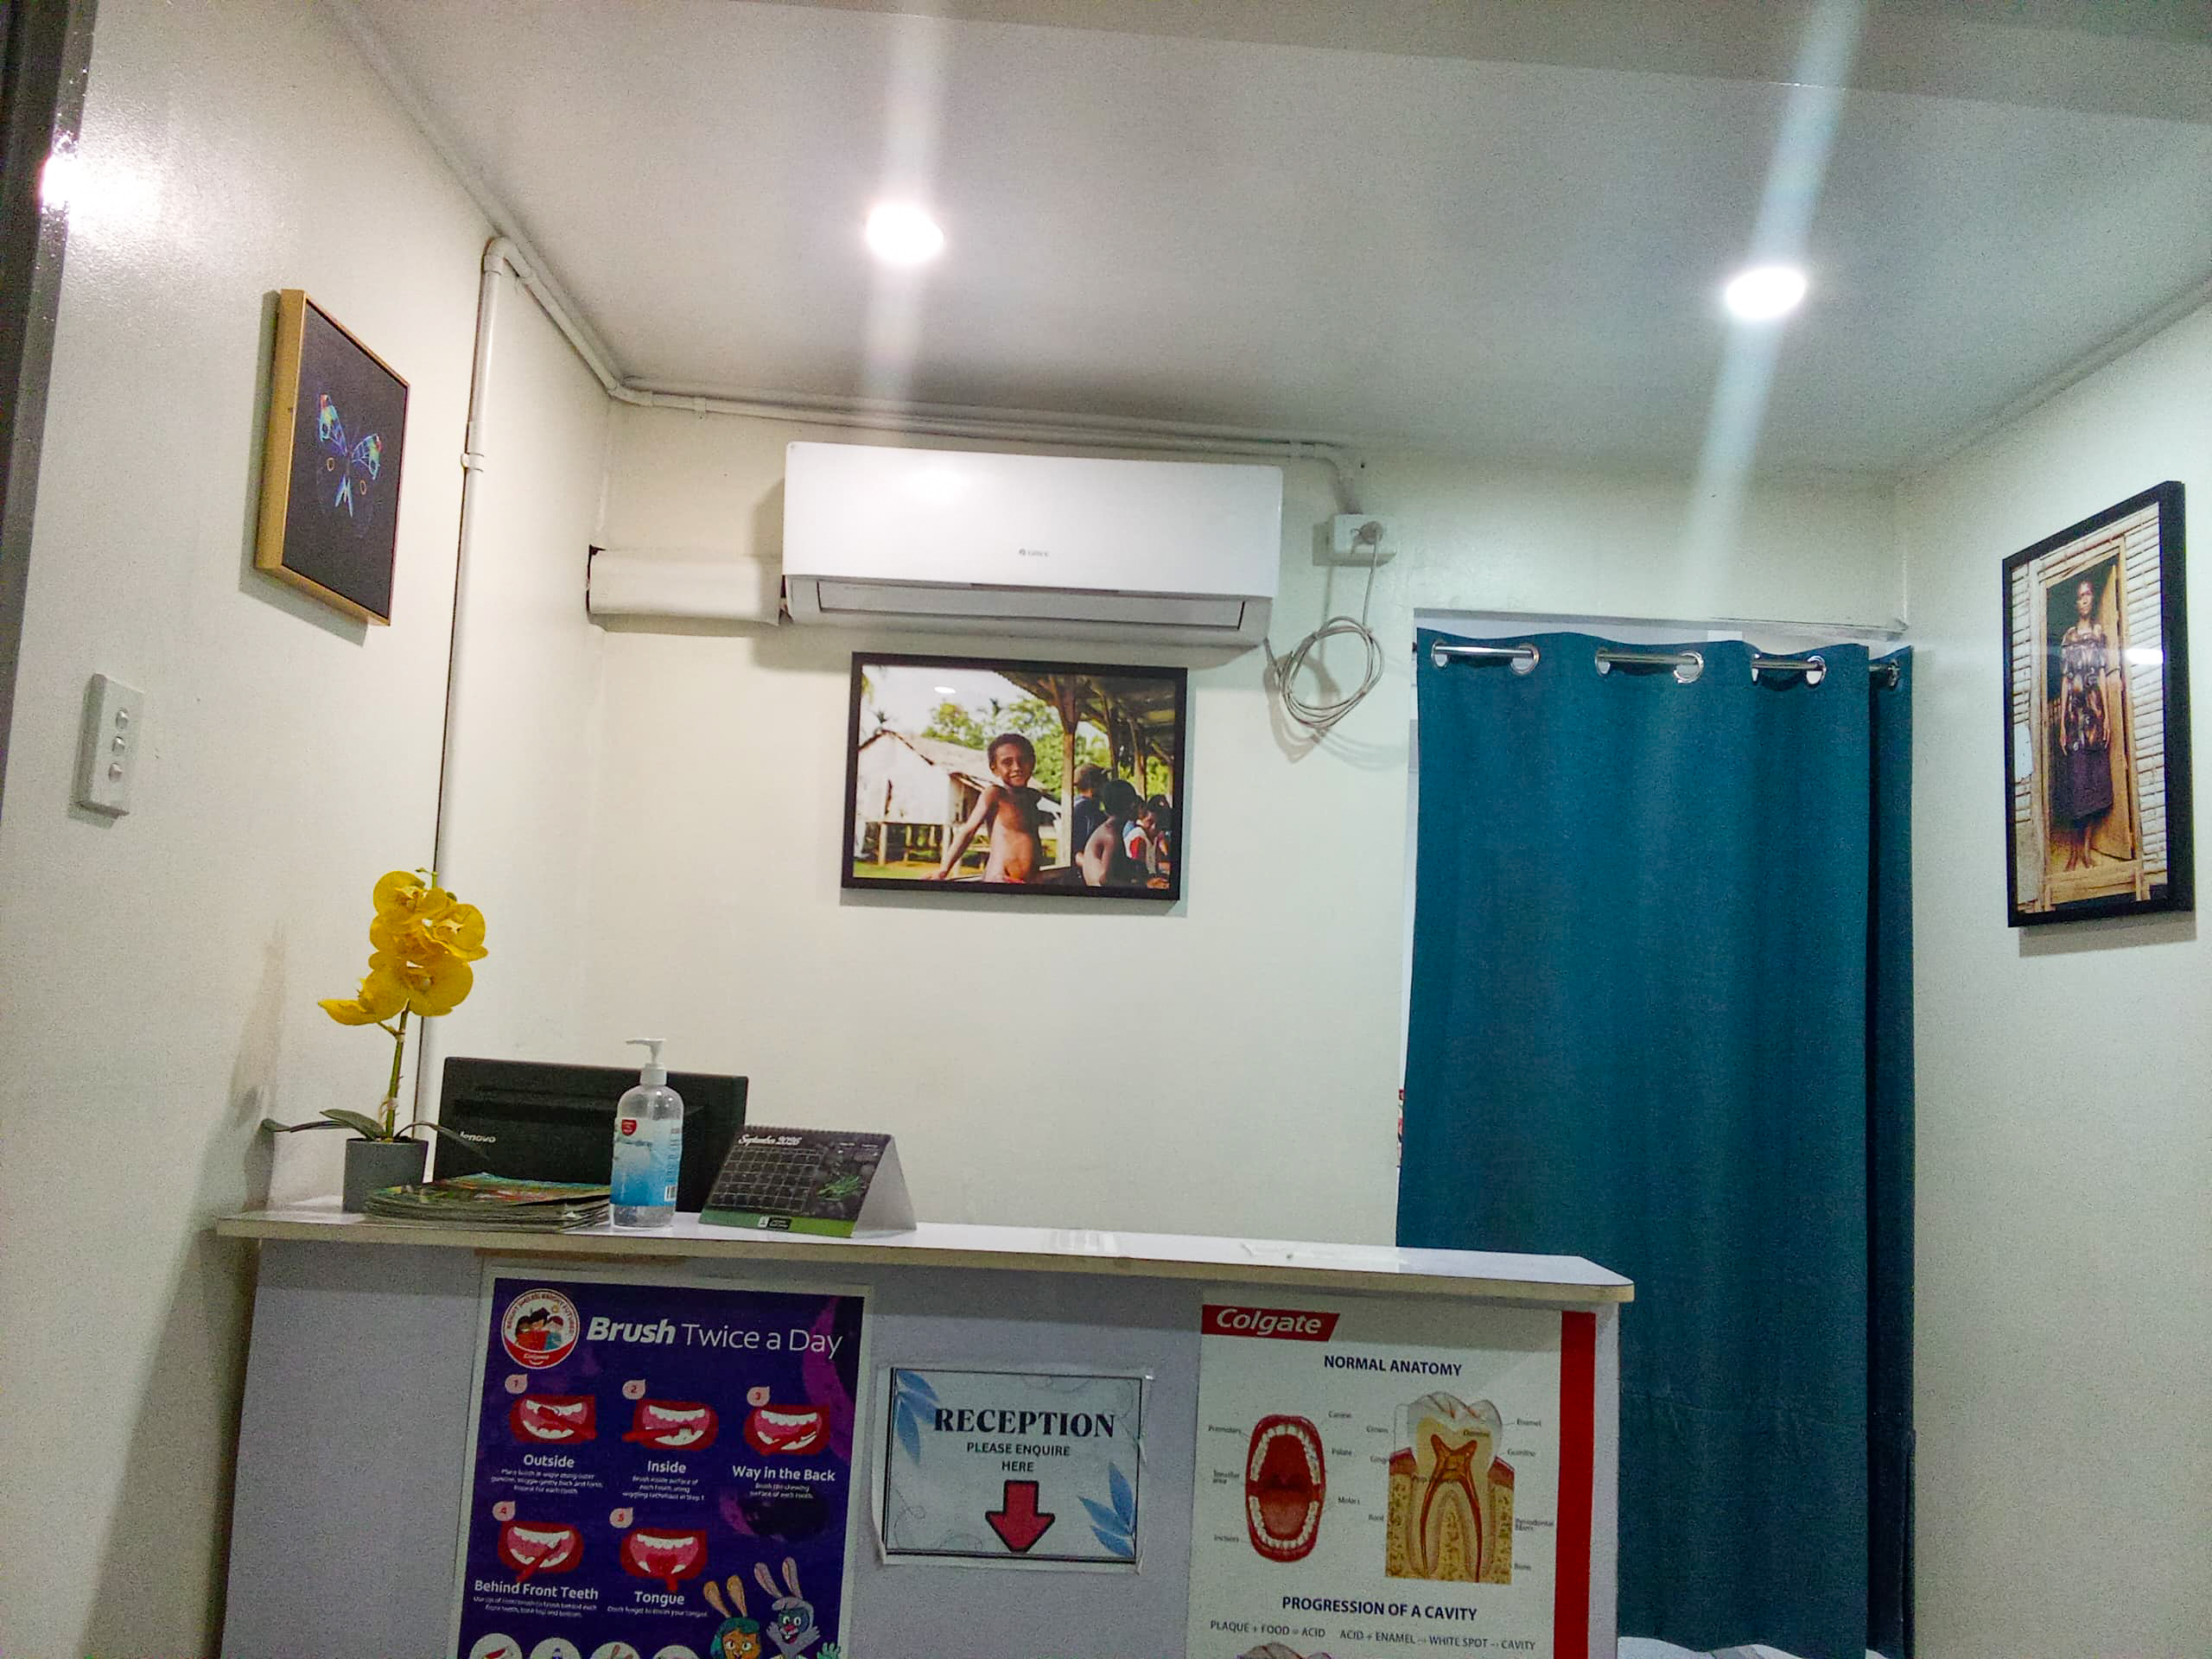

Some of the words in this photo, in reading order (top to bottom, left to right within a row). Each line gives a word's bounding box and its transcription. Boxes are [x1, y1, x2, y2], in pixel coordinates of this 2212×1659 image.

[1217, 1308, 1323, 1336] Colgate
[587, 1316, 676, 1344] Brush
[681, 1323, 760, 1349] Twice
[766, 1332, 781, 1351] a
[789, 1328, 843, 1360] Day
[1323, 1355, 1386, 1371] NORMAL
[1389, 1360, 1462, 1376] ANATOMY
[630, 1384, 638, 1394] 2
[754, 1391, 762, 1401] 3
[934, 1408, 1115, 1439] RECEPTION
[967, 1441, 1013, 1454] PLEASE
[1015, 1443, 1071, 1457] ENQUIRE
[524, 1453, 575, 1468] Outside
[647, 1460, 686, 1473] Inside
[1001, 1461, 1034, 1472] HERE
[733, 1465, 761, 1482] Way
[764, 1465, 776, 1478] in
[779, 1467, 801, 1480] the
[804, 1469, 836, 1482] Back
[499, 1506, 508, 1516] 4
[474, 1580, 520, 1594] Behind
[523, 1583, 558, 1598] Front
[560, 1586, 599, 1600] Teeth
[634, 1591, 685, 1607] Tongue
[1282, 1597, 1384, 1615] PROGRESSION
[1388, 1603, 1408, 1617] OF
[1411, 1605, 1421, 1618] A
[1425, 1605, 1478, 1621] CAVITY
[1210, 1620, 1249, 1633] PLAQUE
[1261, 1624, 1290, 1636] FOOD
[1301, 1627, 1325, 1638] ACID
[1340, 1630, 1363, 1640] ACID
[1376, 1631, 1415, 1644] ENAMEL
[1429, 1635, 1460, 1647] WHITE
[1462, 1637, 1489, 1649] SPOT
[1501, 1639, 1536, 1650] CAVITY
